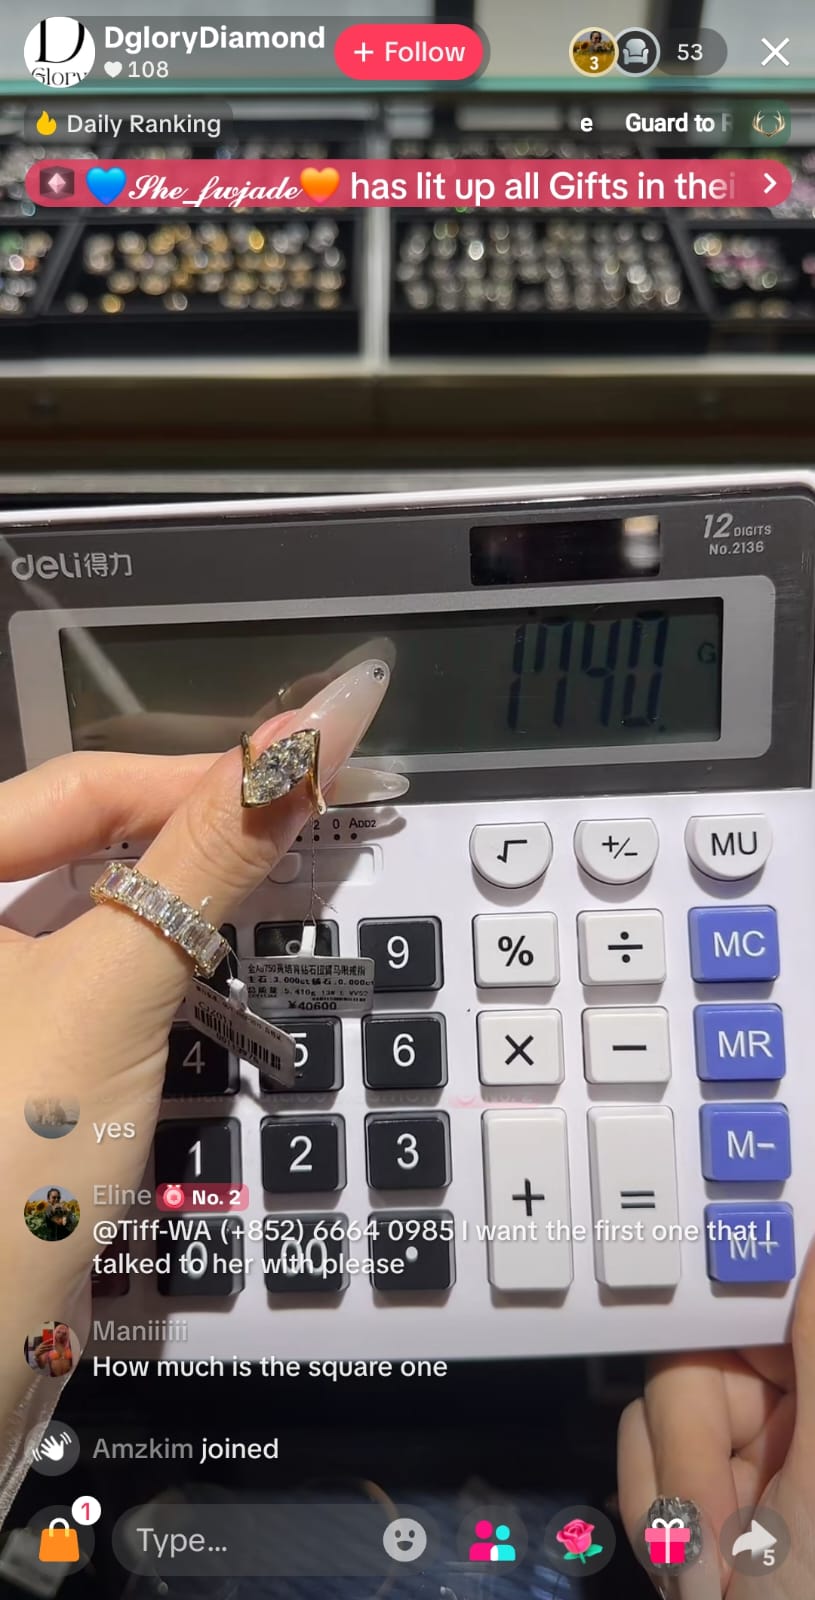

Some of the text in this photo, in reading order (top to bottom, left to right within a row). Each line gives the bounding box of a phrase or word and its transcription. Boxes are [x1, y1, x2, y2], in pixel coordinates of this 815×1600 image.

[703, 513, 734, 539] 12
[709, 541, 765, 556] No.2136
[711, 831, 758, 857] MU
[386, 936, 410, 969] 9
[712, 930, 766, 958] MC
[182, 1040, 206, 1075] 4
[392, 1033, 416, 1067] 6
[717, 1029, 773, 1059] MR
[187, 1139, 203, 1178] 1
[288, 1135, 313, 1173] 2
[396, 1132, 420, 1171] 3
